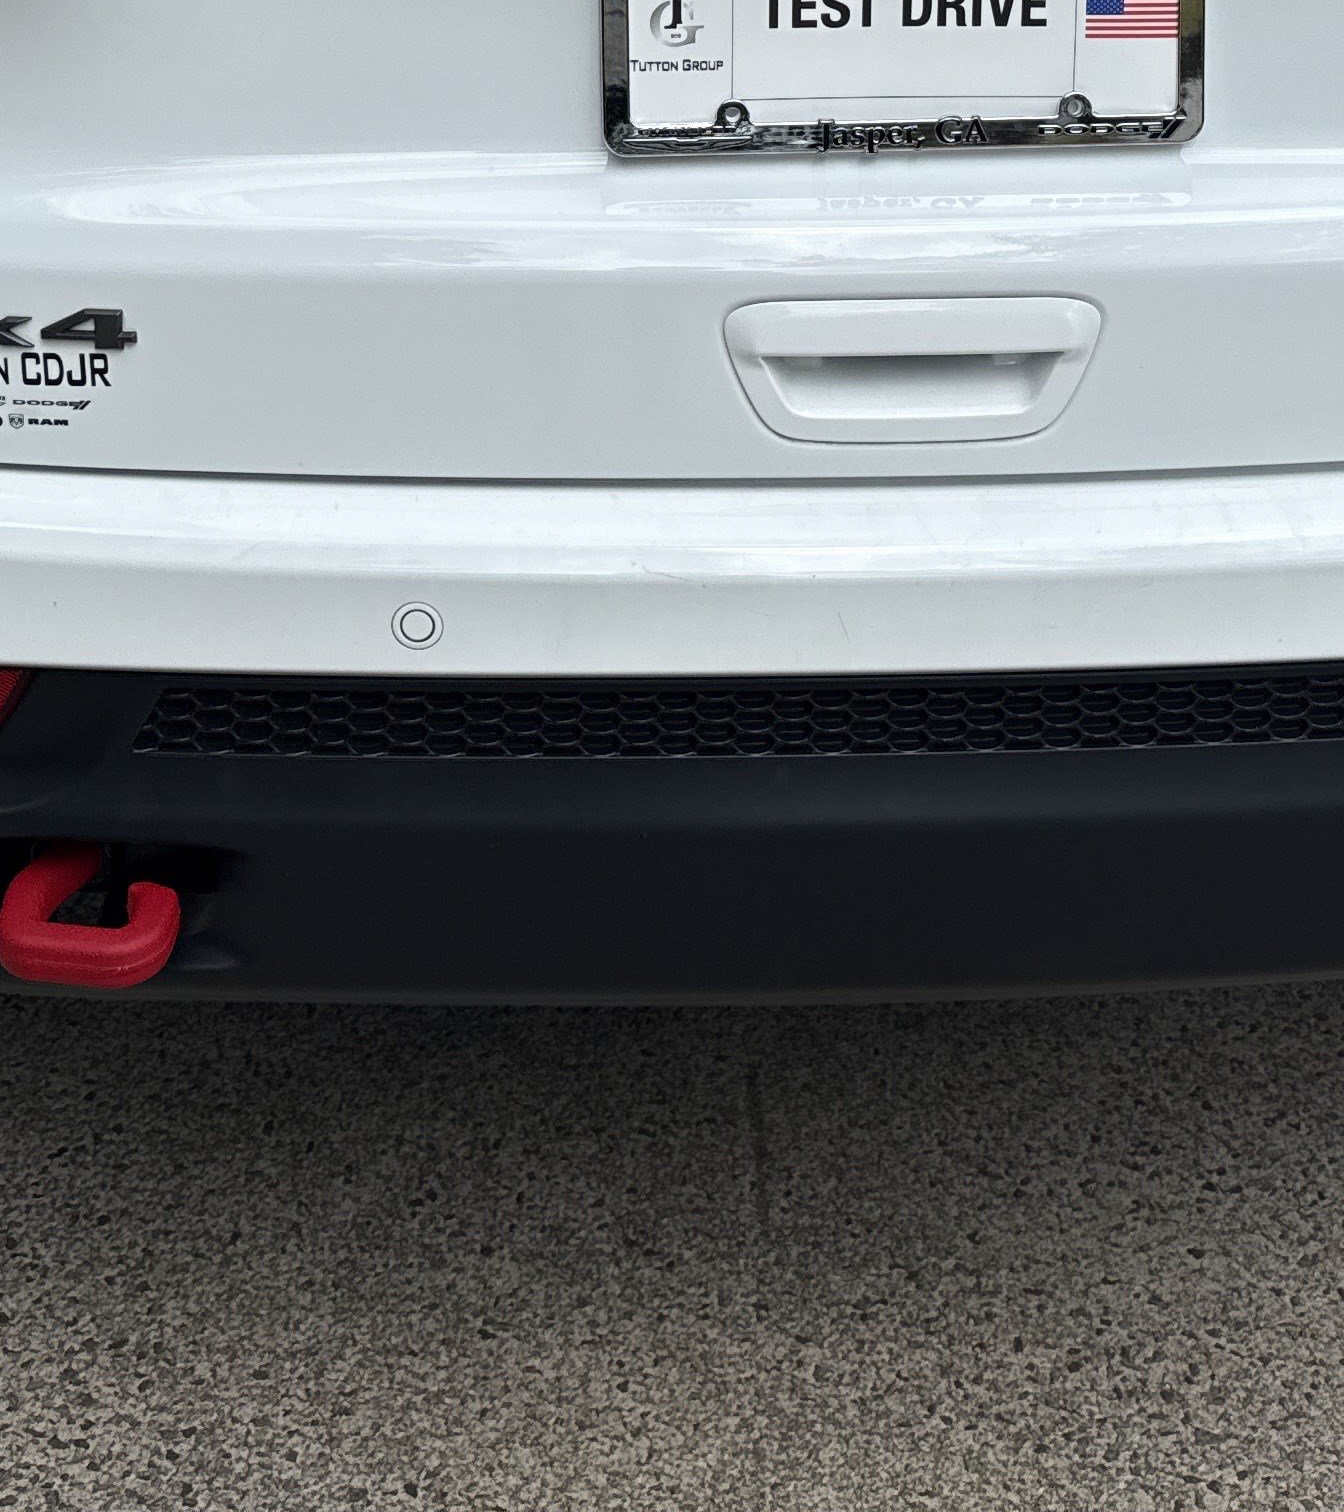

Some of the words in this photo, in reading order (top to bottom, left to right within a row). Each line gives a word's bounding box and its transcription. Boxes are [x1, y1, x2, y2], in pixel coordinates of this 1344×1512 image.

[811, 118, 926, 153] Jasper,
[934, 115, 990, 144] GA
[1037, 122, 1166, 138] DODGE
[20, 352, 112, 387] CDJR
[12, 398, 78, 407] DODGE
[27, 418, 70, 427] RAM
